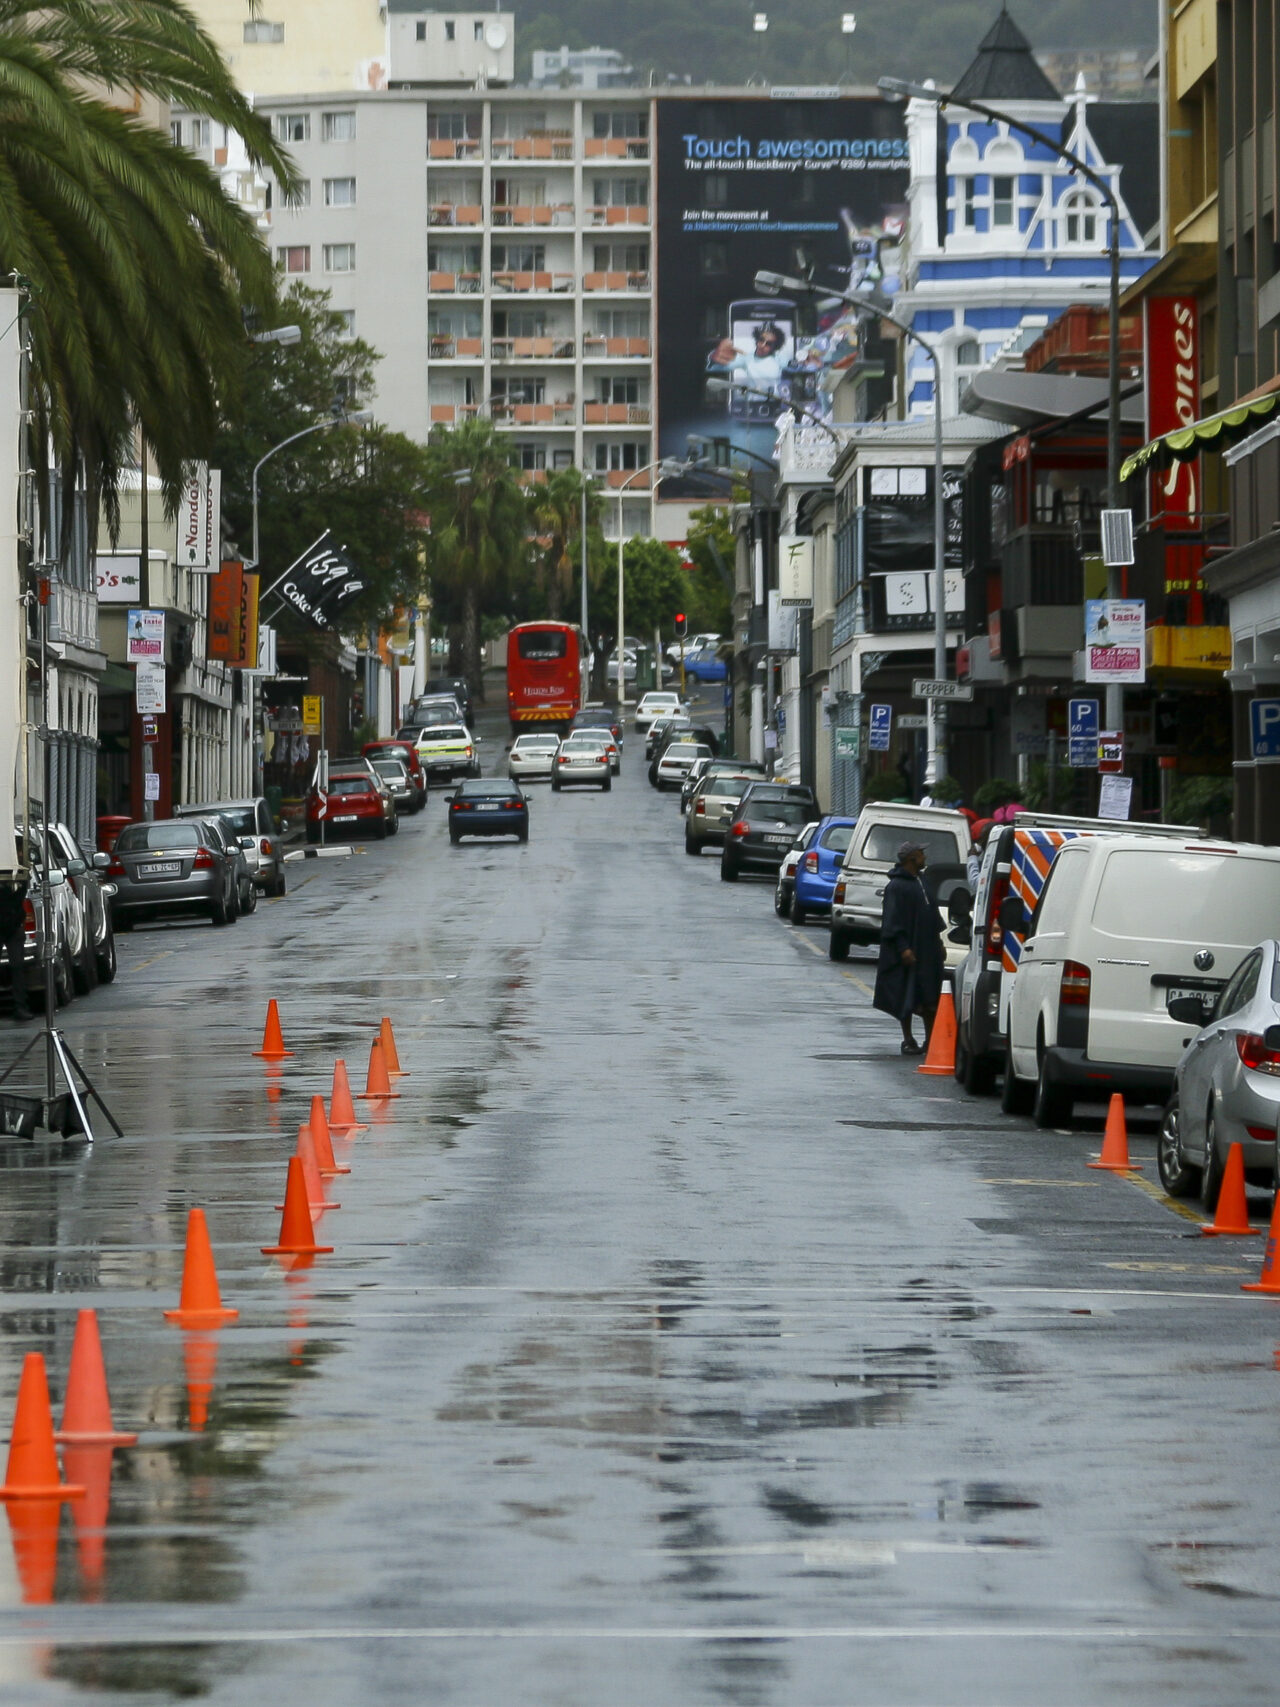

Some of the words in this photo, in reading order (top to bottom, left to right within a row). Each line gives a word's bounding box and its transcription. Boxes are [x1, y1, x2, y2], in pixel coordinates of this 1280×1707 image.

[682, 134, 750, 158] Touch
[684, 159, 701, 170] The
[683, 210, 700, 220] Join
[702, 210, 715, 220] the
[716, 211, 759, 220] movement
[283, 582, 311, 613] Coke
[920, 683, 956, 696] PEPPER
[876, 708, 886, 719] P
[1077, 704, 1092, 720] P
[5, 1111, 24, 1134] W
